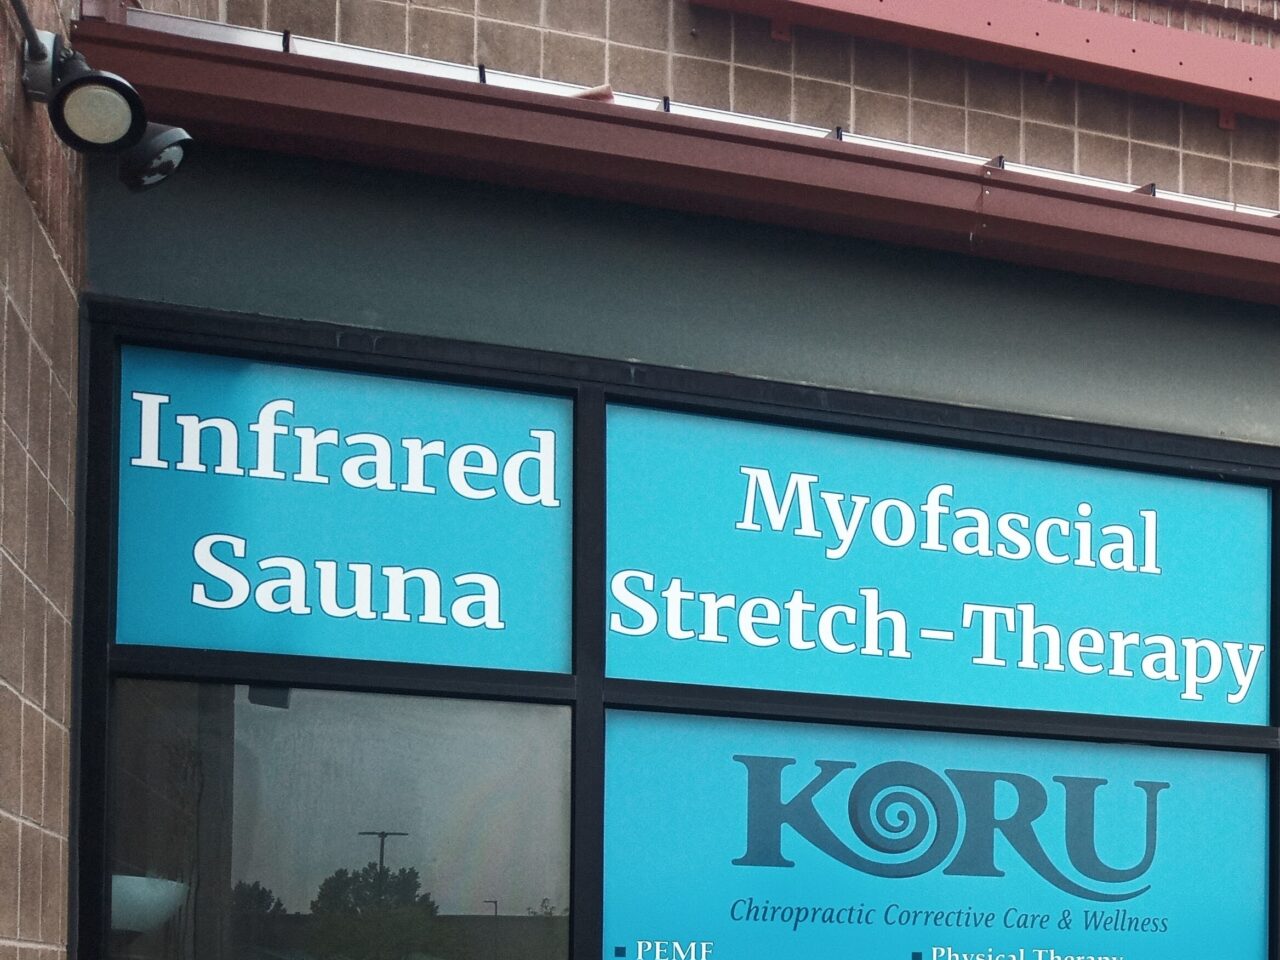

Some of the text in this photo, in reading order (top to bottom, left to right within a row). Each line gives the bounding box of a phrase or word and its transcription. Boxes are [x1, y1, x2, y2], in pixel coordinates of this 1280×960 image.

[130, 391, 561, 508] Infrared
[735, 465, 1161, 575] Myofascial
[192, 533, 505, 630] Sauna
[731, 754, 1171, 902] KORU
[729, 897, 1168, 933] Chiropractic Corrective Care & Wellness
